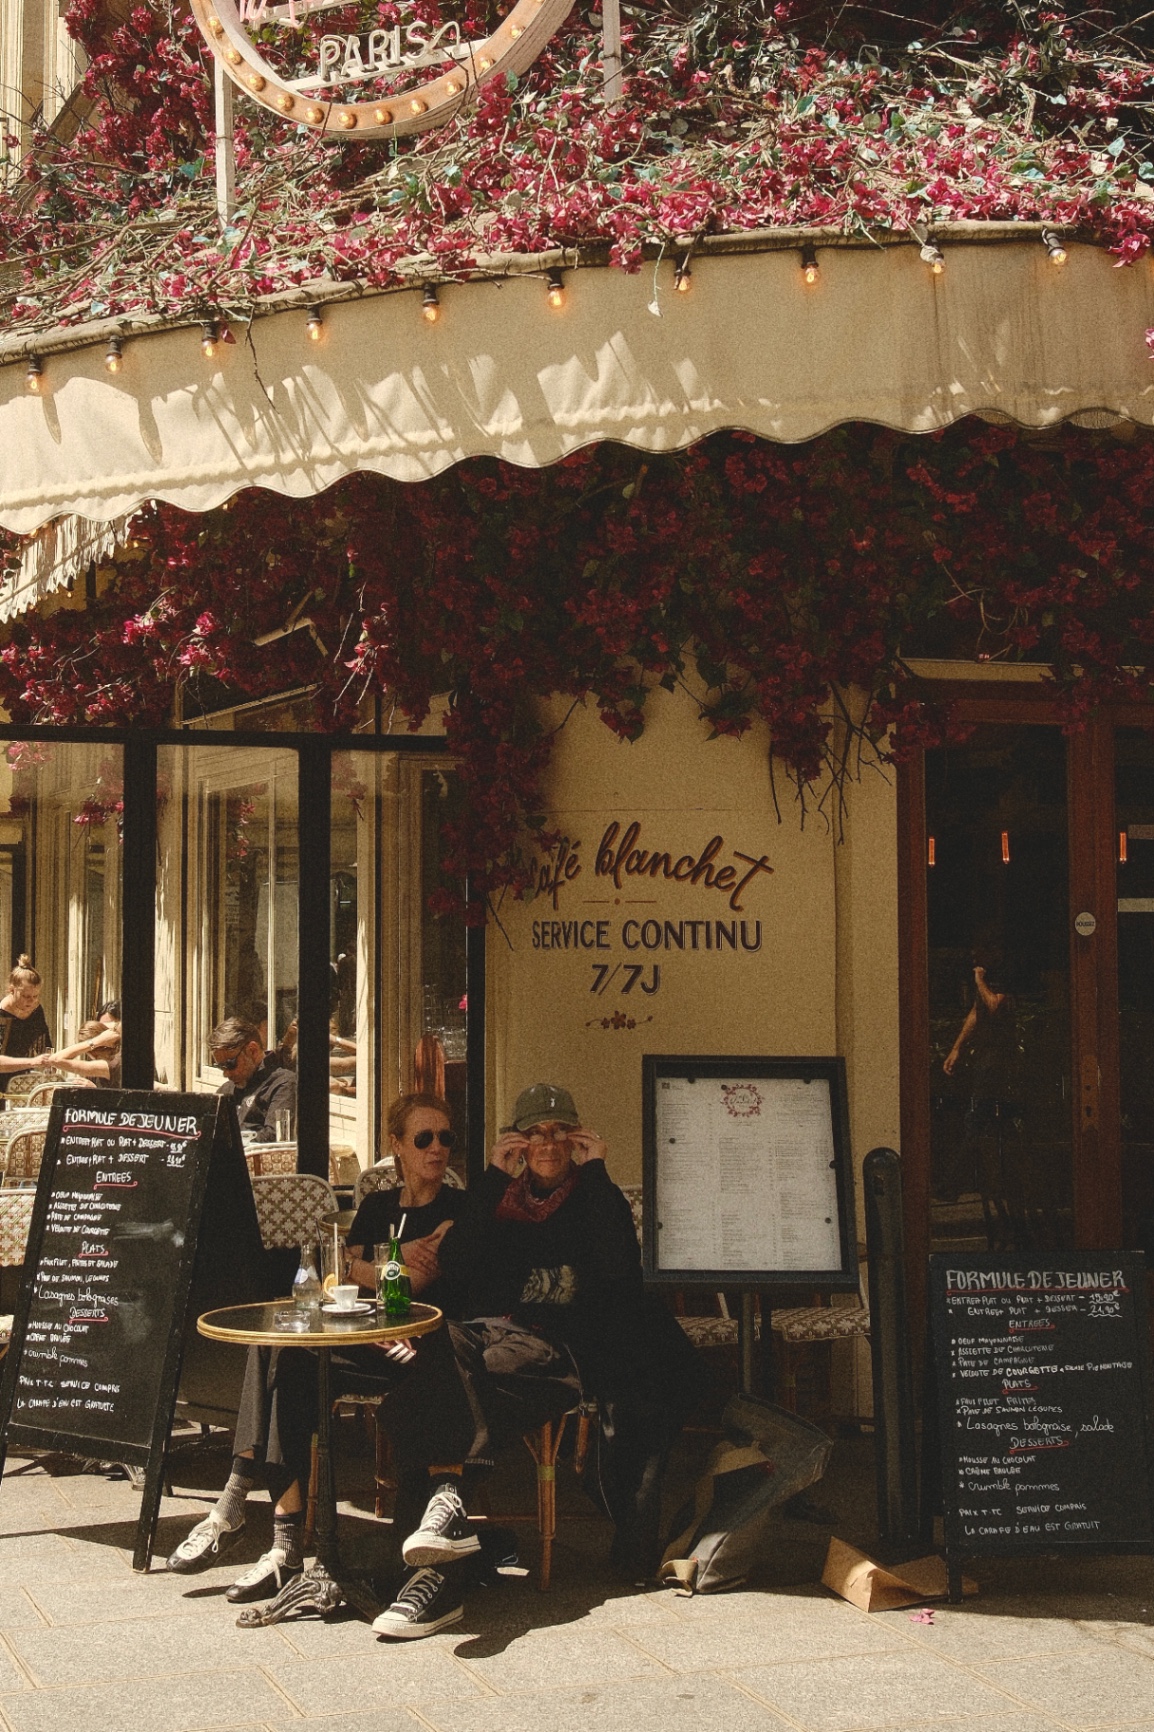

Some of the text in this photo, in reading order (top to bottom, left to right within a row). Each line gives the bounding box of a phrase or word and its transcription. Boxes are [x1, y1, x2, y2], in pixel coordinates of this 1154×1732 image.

[319, 22, 460, 82] PARIS
[532, 918, 762, 951] SERVICE CONTINU
[589, 962, 661, 995] 7/7J
[65, 1108, 117, 1125] FORMULE
[96, 1171, 132, 1183] ENTREES
[946, 1270, 1025, 1290] FORMULE
[39, 1285, 75, 1307] Lasagnes
[1016, 1295, 1033, 1304] PLAT
[1009, 1306, 1027, 1315] PLAT
[1009, 1318, 1050, 1328] ENTREES
[1002, 1378, 1032, 1389] PLATS
[967, 1417, 1019, 1437] Lasagnes
[1080, 1415, 1114, 1433] salade
[1010, 1436, 1063, 1449] DESSERTS
[979, 1526, 1011, 1535] CARAFE
[1045, 1522, 1060, 1531] EST
[1064, 1521, 1101, 1531] GRATUIT
